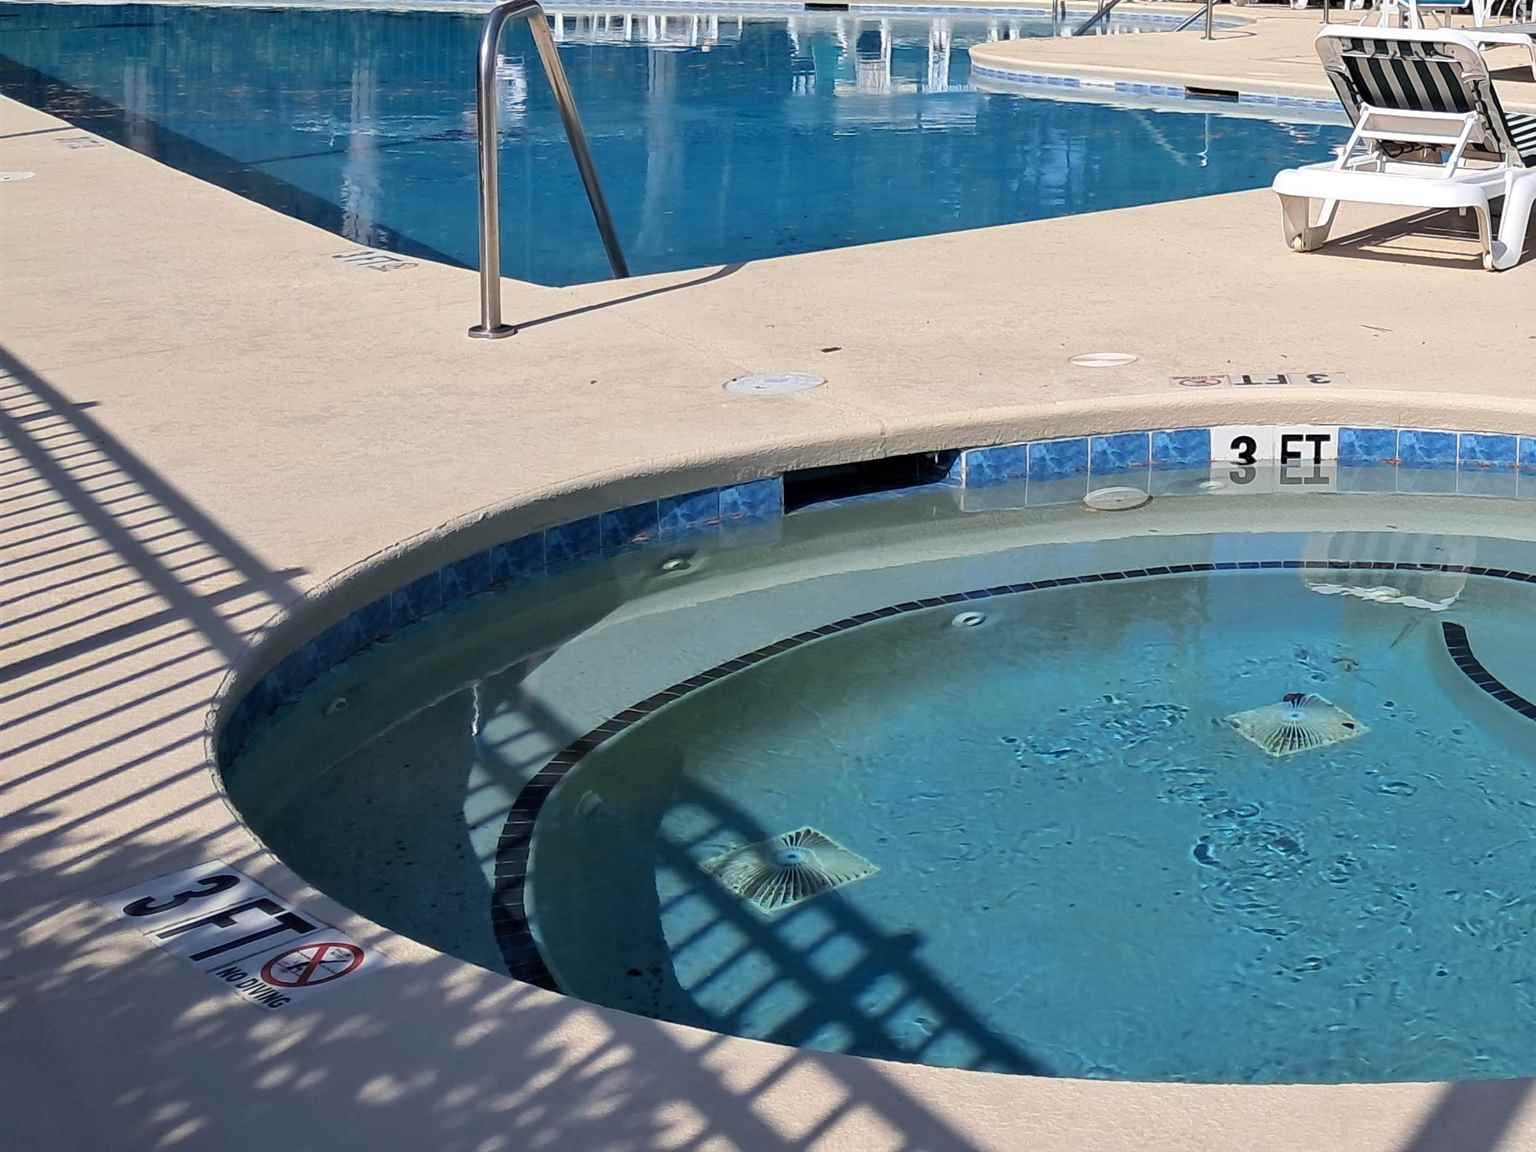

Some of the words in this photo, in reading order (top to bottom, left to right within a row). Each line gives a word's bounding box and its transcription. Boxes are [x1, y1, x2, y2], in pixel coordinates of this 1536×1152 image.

[1234, 374, 1288, 385] FT
[1306, 373, 1331, 384] 3
[1229, 435, 1257, 465] 3
[1280, 434, 1331, 465] FT
[122, 874, 240, 917] 3
[156, 897, 317, 962] FT
[218, 966, 243, 983] NO
[236, 978, 291, 1009] DIVING
